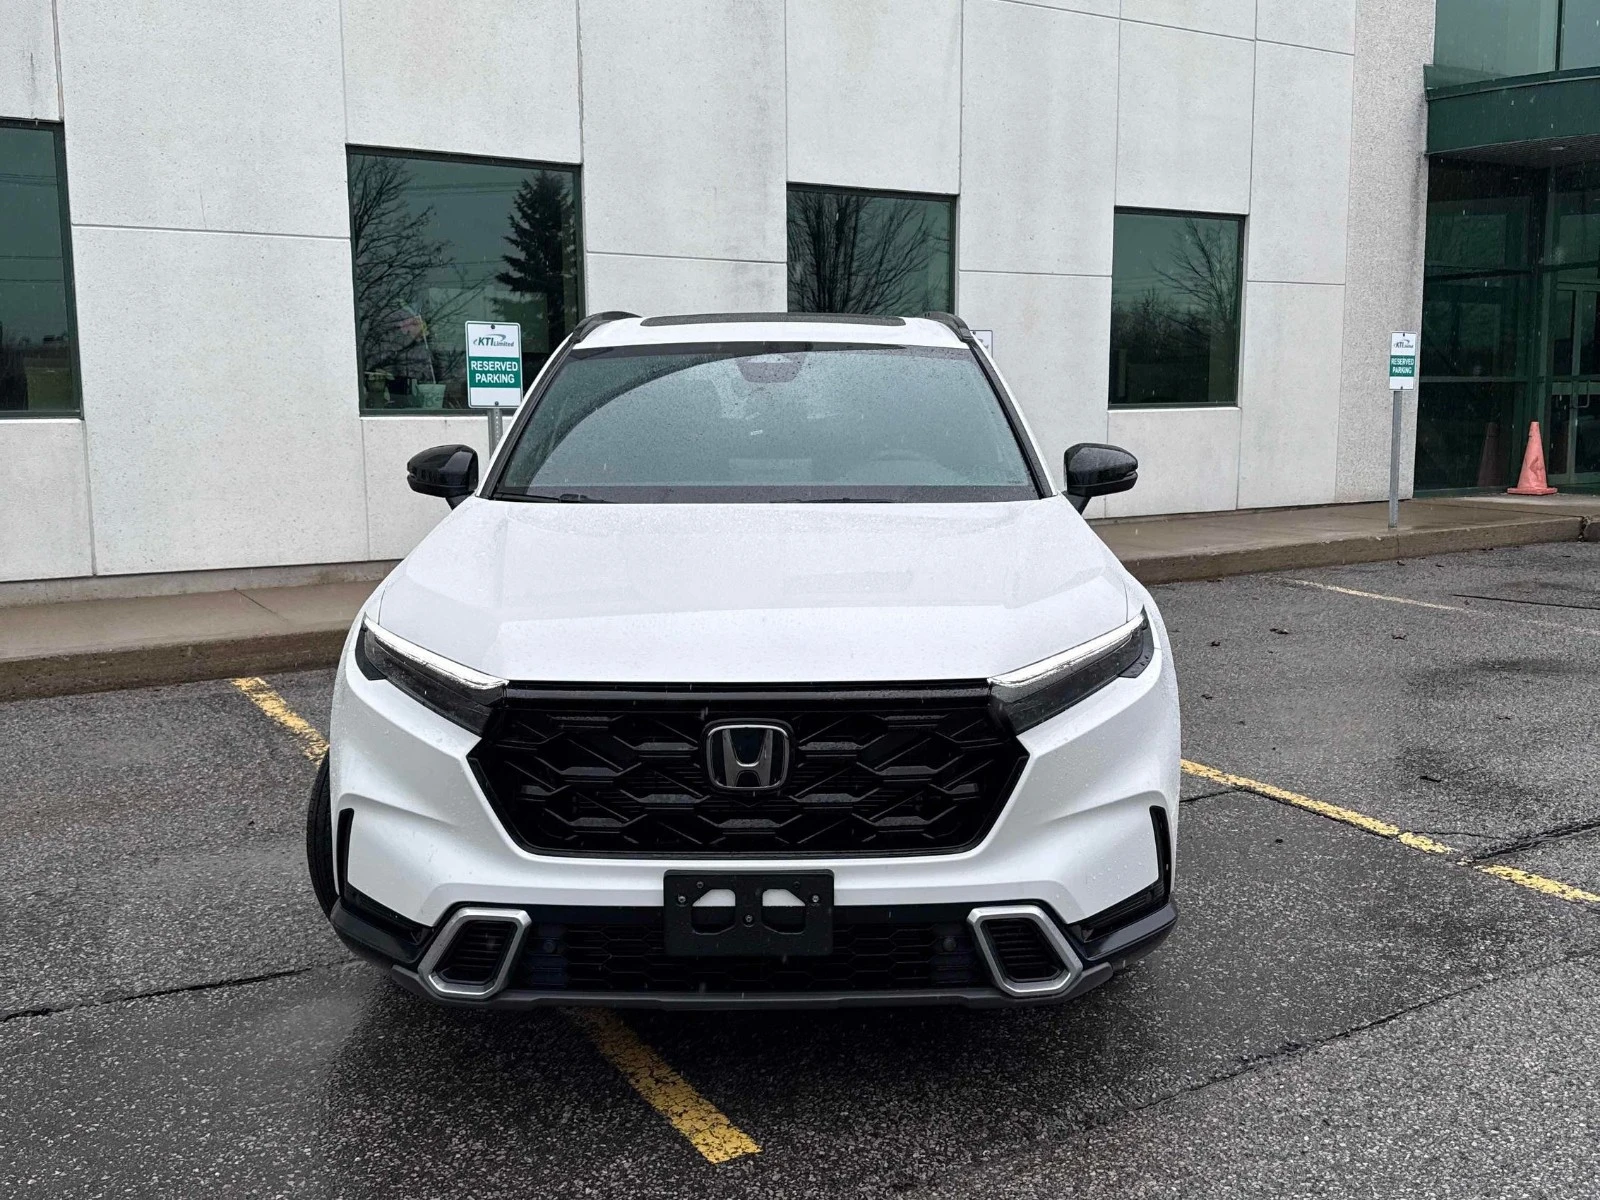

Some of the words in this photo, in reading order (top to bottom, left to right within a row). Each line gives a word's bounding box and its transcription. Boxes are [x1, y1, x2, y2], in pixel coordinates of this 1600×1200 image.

[478, 337, 494, 346] KTI
[471, 361, 518, 371] RESERVED
[476, 373, 515, 383] PARKING
